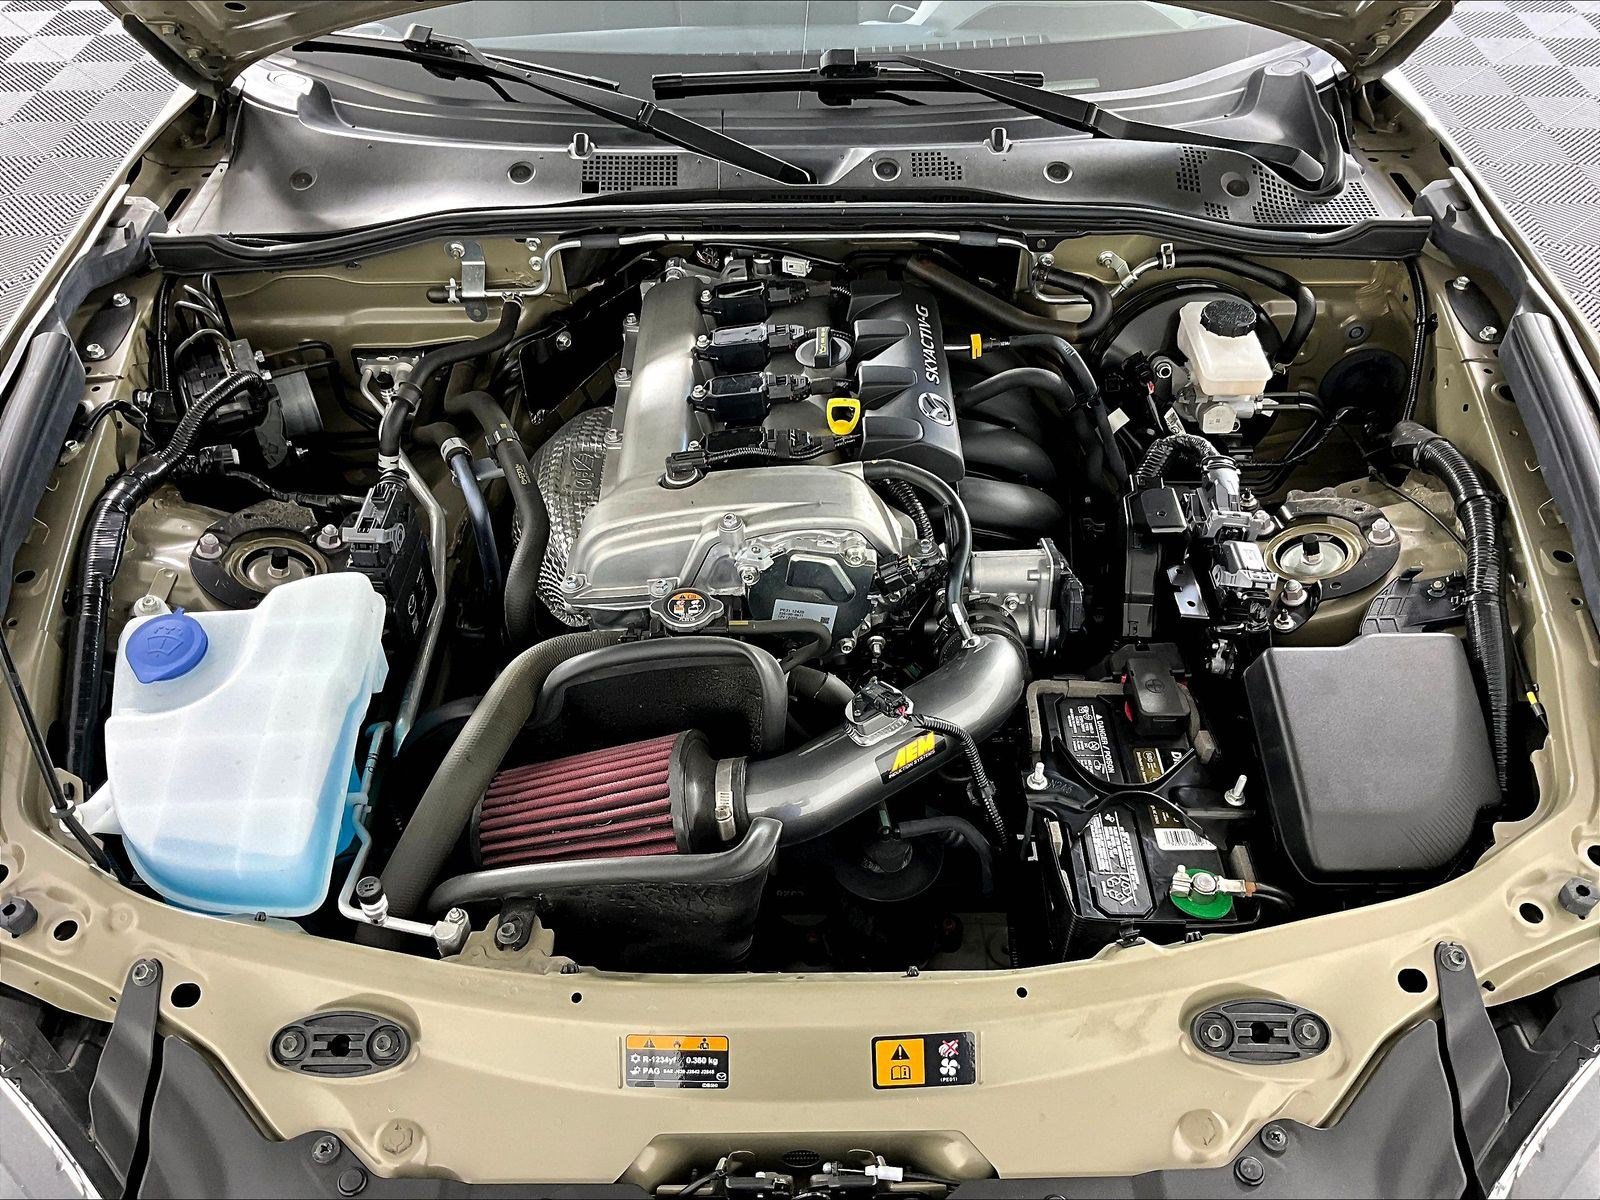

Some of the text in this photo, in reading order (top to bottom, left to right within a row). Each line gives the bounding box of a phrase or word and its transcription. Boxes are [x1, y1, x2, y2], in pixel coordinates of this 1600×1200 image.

[916, 303, 940, 385] SKYACTIV-G
[891, 731, 935, 772] AEM
[914, 749, 936, 765] SYSTEMS
[1097, 720, 1108, 744] DANGER
[1104, 750, 1115, 774] POISON
[642, 1056, 676, 1065] R-1234yf
[708, 1056, 719, 1065] kg
[642, 1067, 660, 1075] PAG
